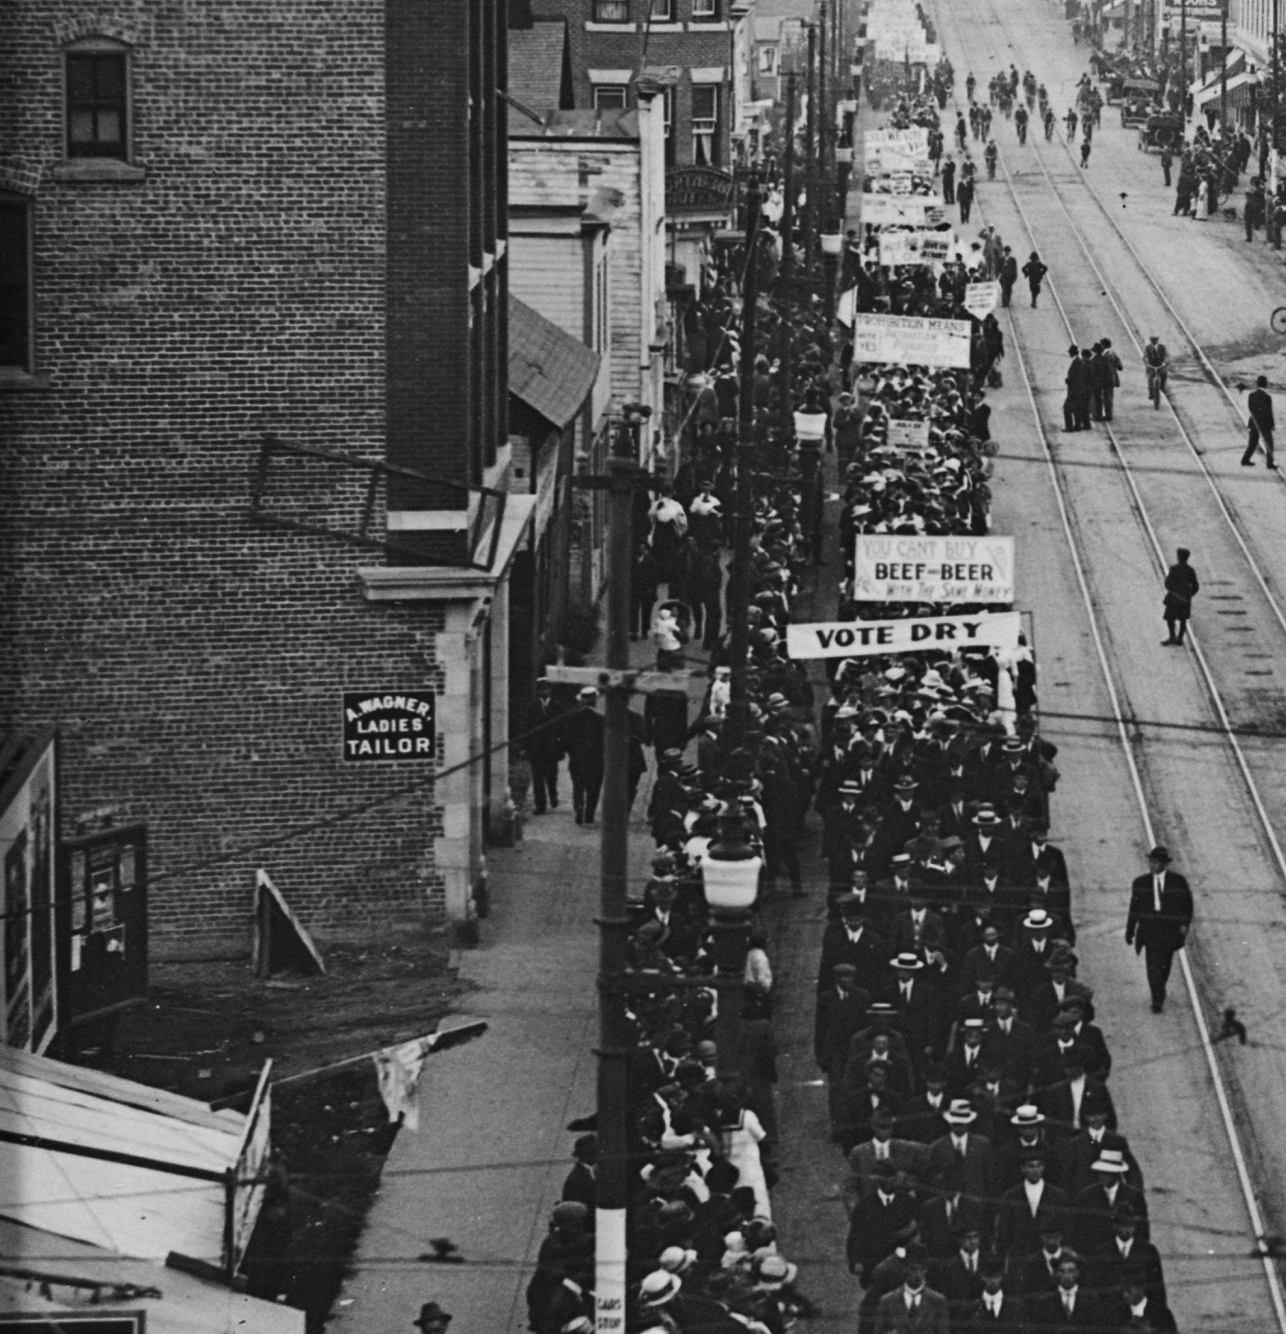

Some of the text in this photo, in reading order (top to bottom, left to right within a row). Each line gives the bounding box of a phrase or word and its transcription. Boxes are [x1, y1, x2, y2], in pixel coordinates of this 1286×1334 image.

[928, 320, 965, 332] MEANS
[863, 540, 892, 557] YOU
[945, 541, 977, 558] BUY
[875, 563, 926, 580] BEEF
[941, 564, 993, 581] BEER
[816, 622, 982, 649] VOTE DRY
[357, 718, 423, 733] LADIES
[347, 737, 430, 755] TAILOR
